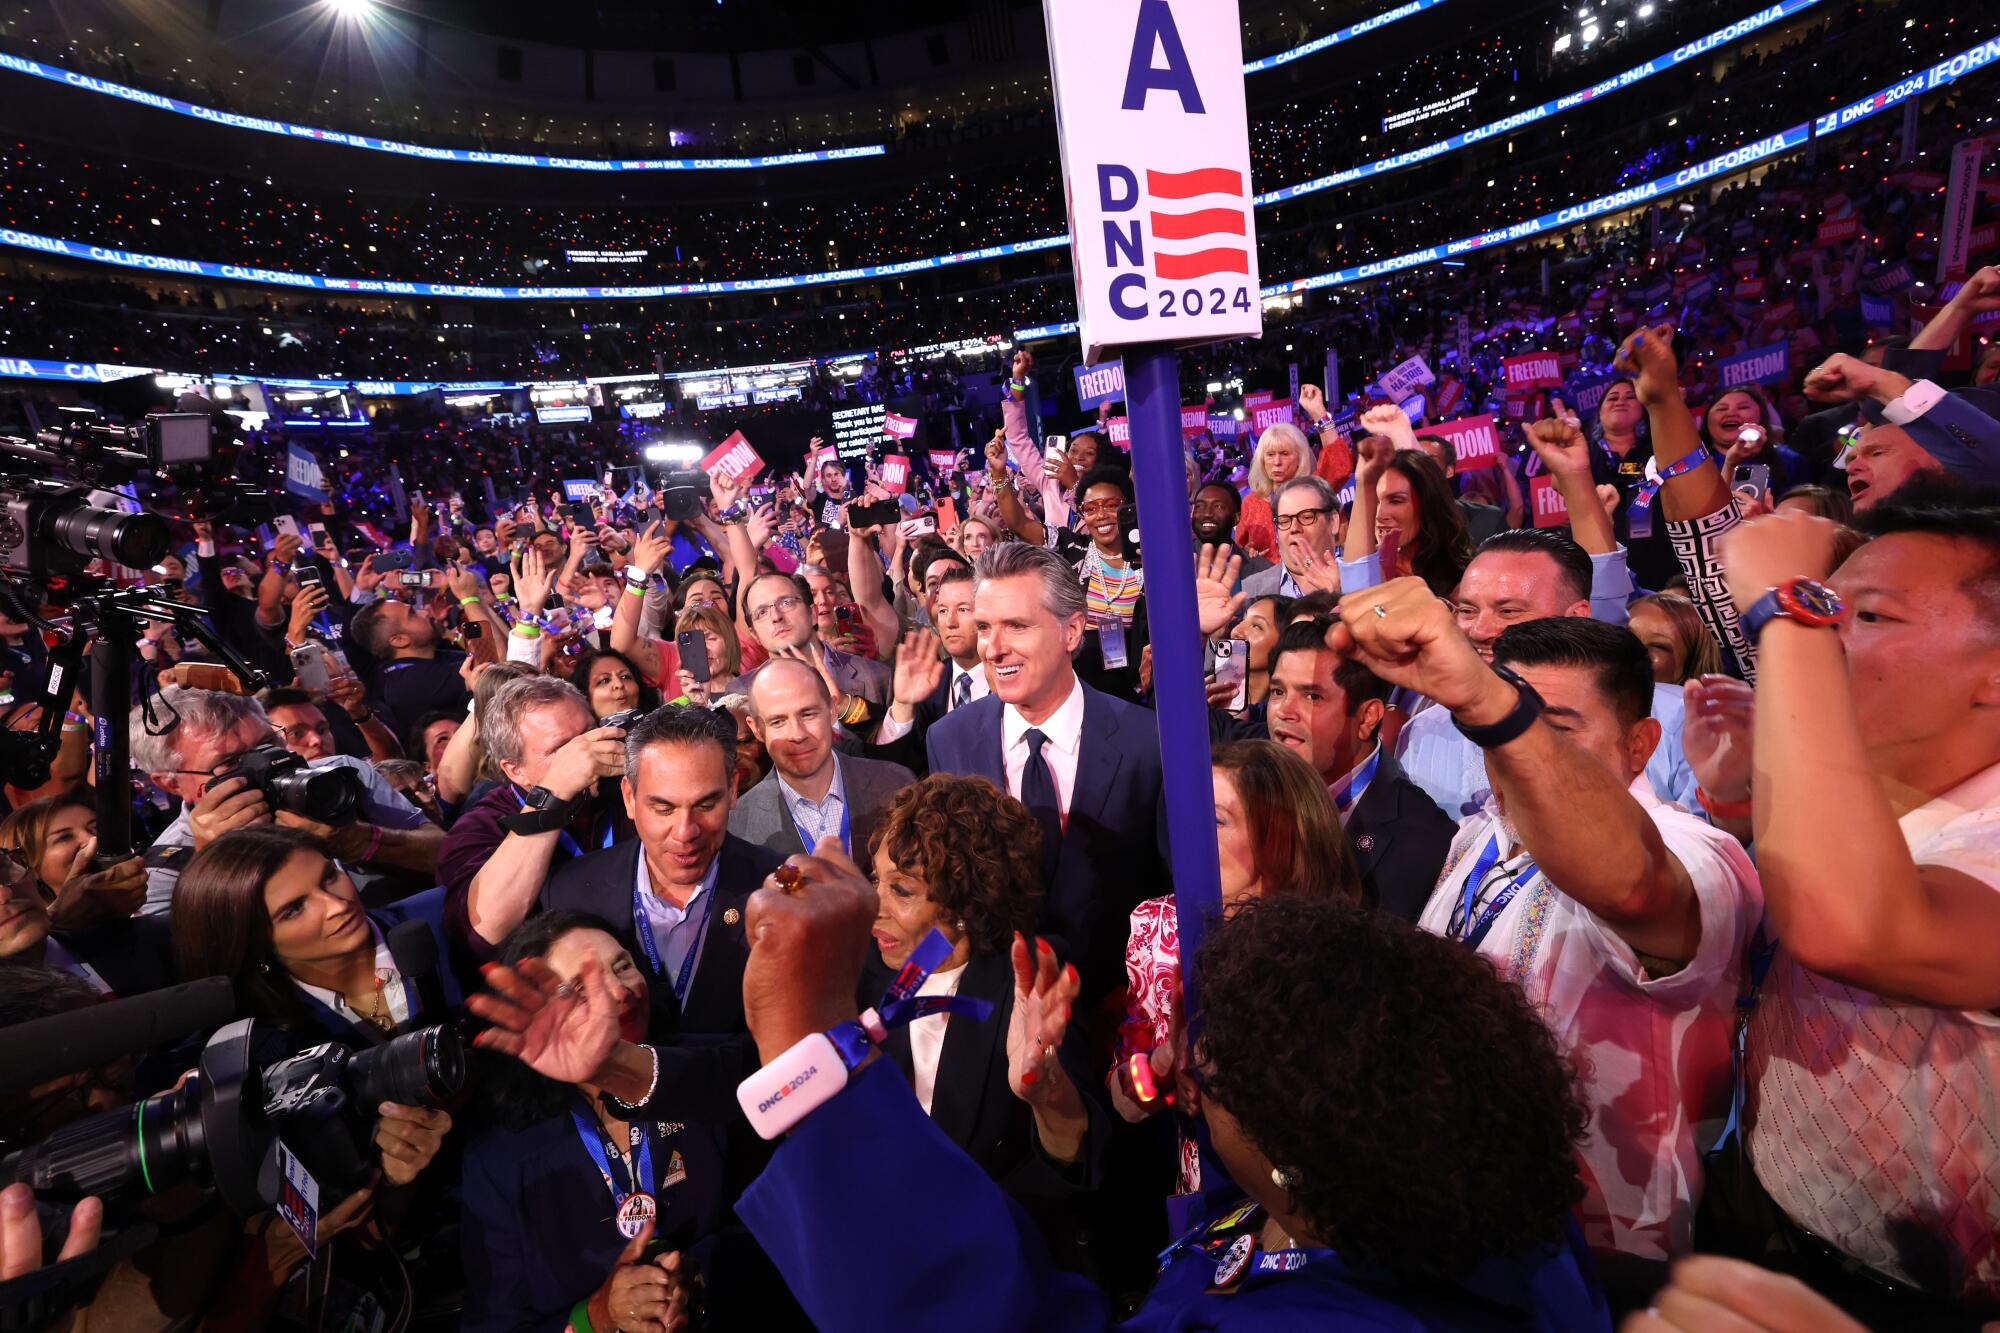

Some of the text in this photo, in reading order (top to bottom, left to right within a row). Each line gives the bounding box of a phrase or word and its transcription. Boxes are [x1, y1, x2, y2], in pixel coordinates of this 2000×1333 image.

[1351, 2, 1421, 36] CALIFORNIA
[1673, 5, 1784, 62] CALIFORNIA
[1121, 0, 1206, 114] A
[1275, 34, 1340, 64] CALIFORNIA
[66, 72, 174, 111] CALIFORNIA
[1557, 79, 1618, 109] DNC 2024
[1841, 75, 1924, 123] DNC 2024
[191, 105, 285, 134] CALIFORNIA
[1463, 106, 1546, 143] CALIFORNIA
[381, 141, 456, 160] CALIFORNIA
[468, 151, 538, 166] CALIFORNIA
[549, 157, 613, 171] CALIFORNIA
[694, 159, 752, 169] CALIFORNIA
[762, 152, 818, 166] CALIFORNIA
[827, 145, 883, 159] CALIFORNIA
[1374, 140, 1449, 172] CALIFORNIA
[1676, 133, 1787, 186] CALIFORNIA
[1292, 168, 1361, 195] CALIFORNIA
[1557, 181, 1658, 224] CALIFORNIA
[1097, 164, 1149, 321] DNC
[1448, 230, 1508, 254] DNC 2024
[89, 247, 204, 274] CALIFORNIA
[875, 259, 934, 276] CALIFORNIA
[1358, 248, 1438, 277] CALIFORNIA
[220, 265, 316, 287] CALIFORNIA
[734, 277, 796, 290] CALIFORNIA
[805, 268, 866, 283] CALIFORNIA
[430, 284, 505, 298] CALIFORNIA
[518, 287, 589, 298] CALIFORNIA
[1158, 287, 1251, 318] 2024
[103, 368, 124, 378] BBC
[1390, 366, 1424, 393] HARRIS
[1508, 359, 1559, 384] FREEDOM
[1723, 350, 1785, 388] FREEDOM
[1079, 366, 1123, 400] FREEDO
[832, 406, 871, 420] SECRETARY
[871, 404, 886, 413] RAE
[853, 418, 866, 428] you
[865, 417, 873, 425] to
[885, 416, 914, 435] FREEDOM
[1495, 882, 1521, 905] DNC
[758, 1065, 818, 1113] DNC 2024
[1259, 1254, 1279, 1270] DNC
